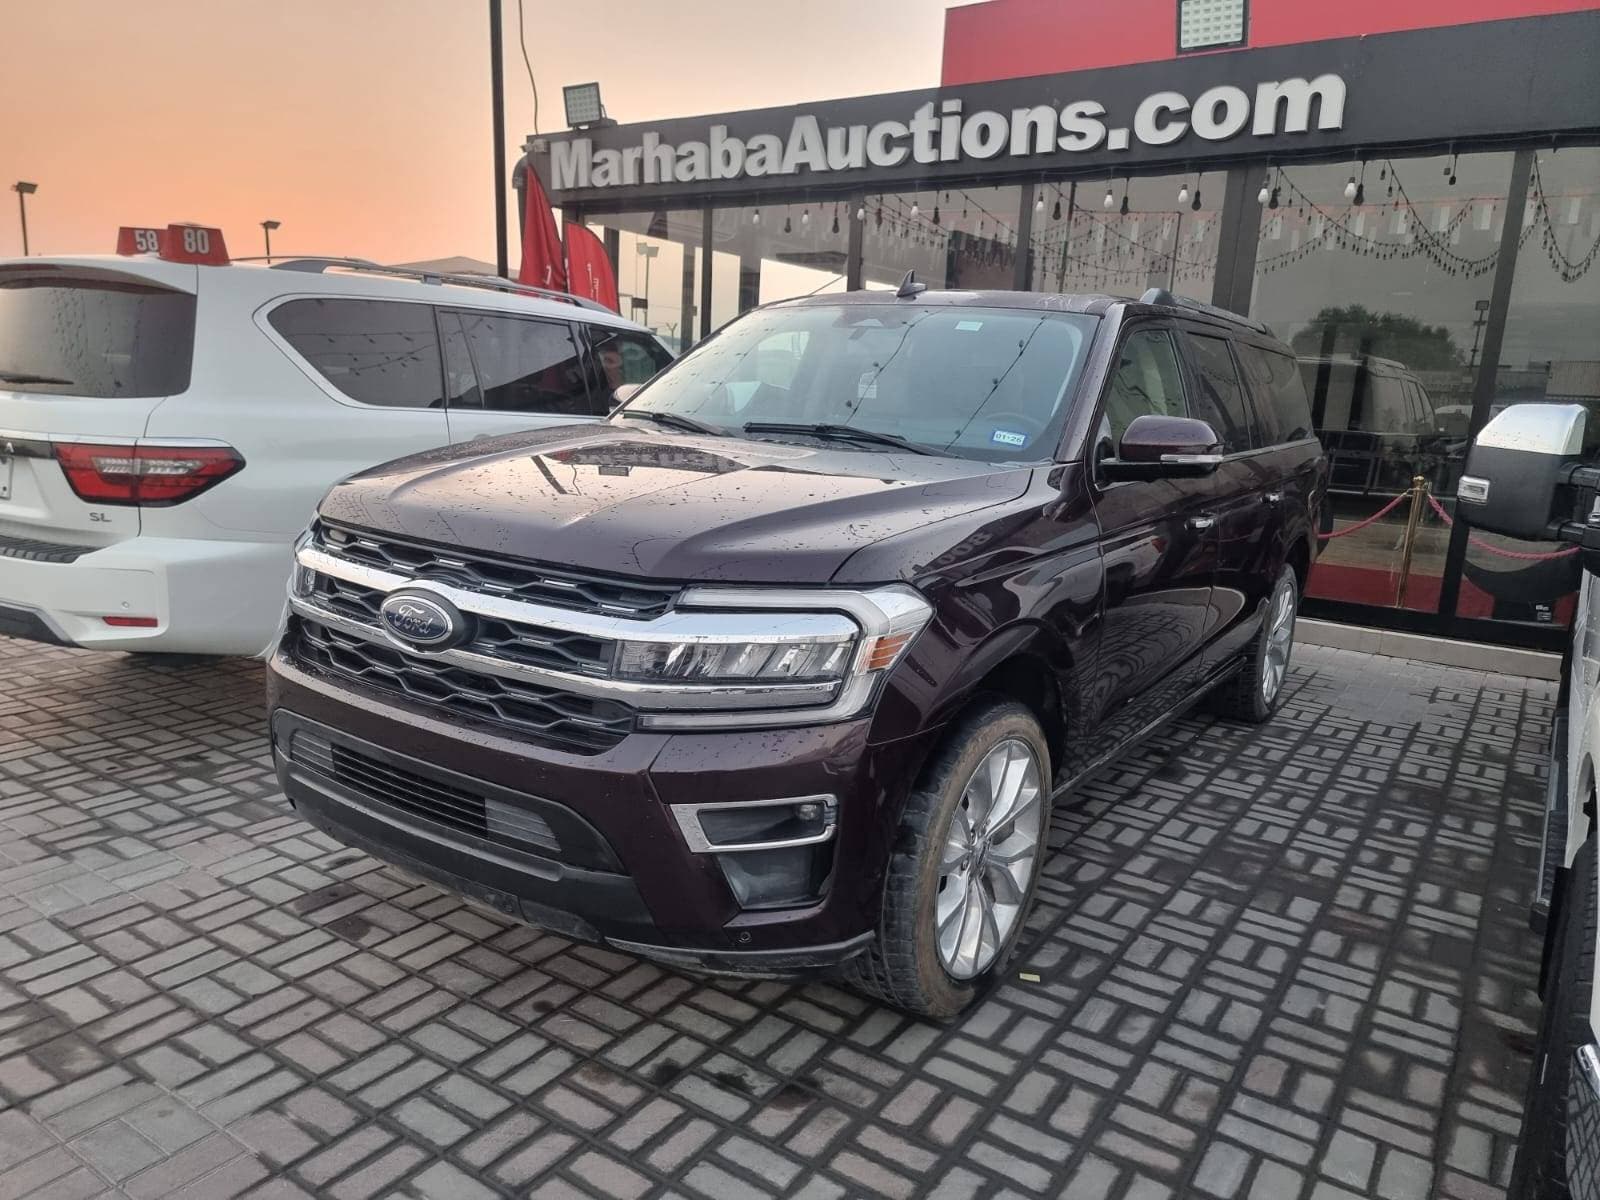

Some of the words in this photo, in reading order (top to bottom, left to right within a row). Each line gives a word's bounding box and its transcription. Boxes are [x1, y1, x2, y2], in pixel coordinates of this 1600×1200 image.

[550, 74, 1347, 191] MarhabaAuctions.com
[134, 230, 159, 251] 58
[183, 228, 210, 254] 80
[89, 511, 113, 522] SL
[394, 604, 433, 634] Ford
